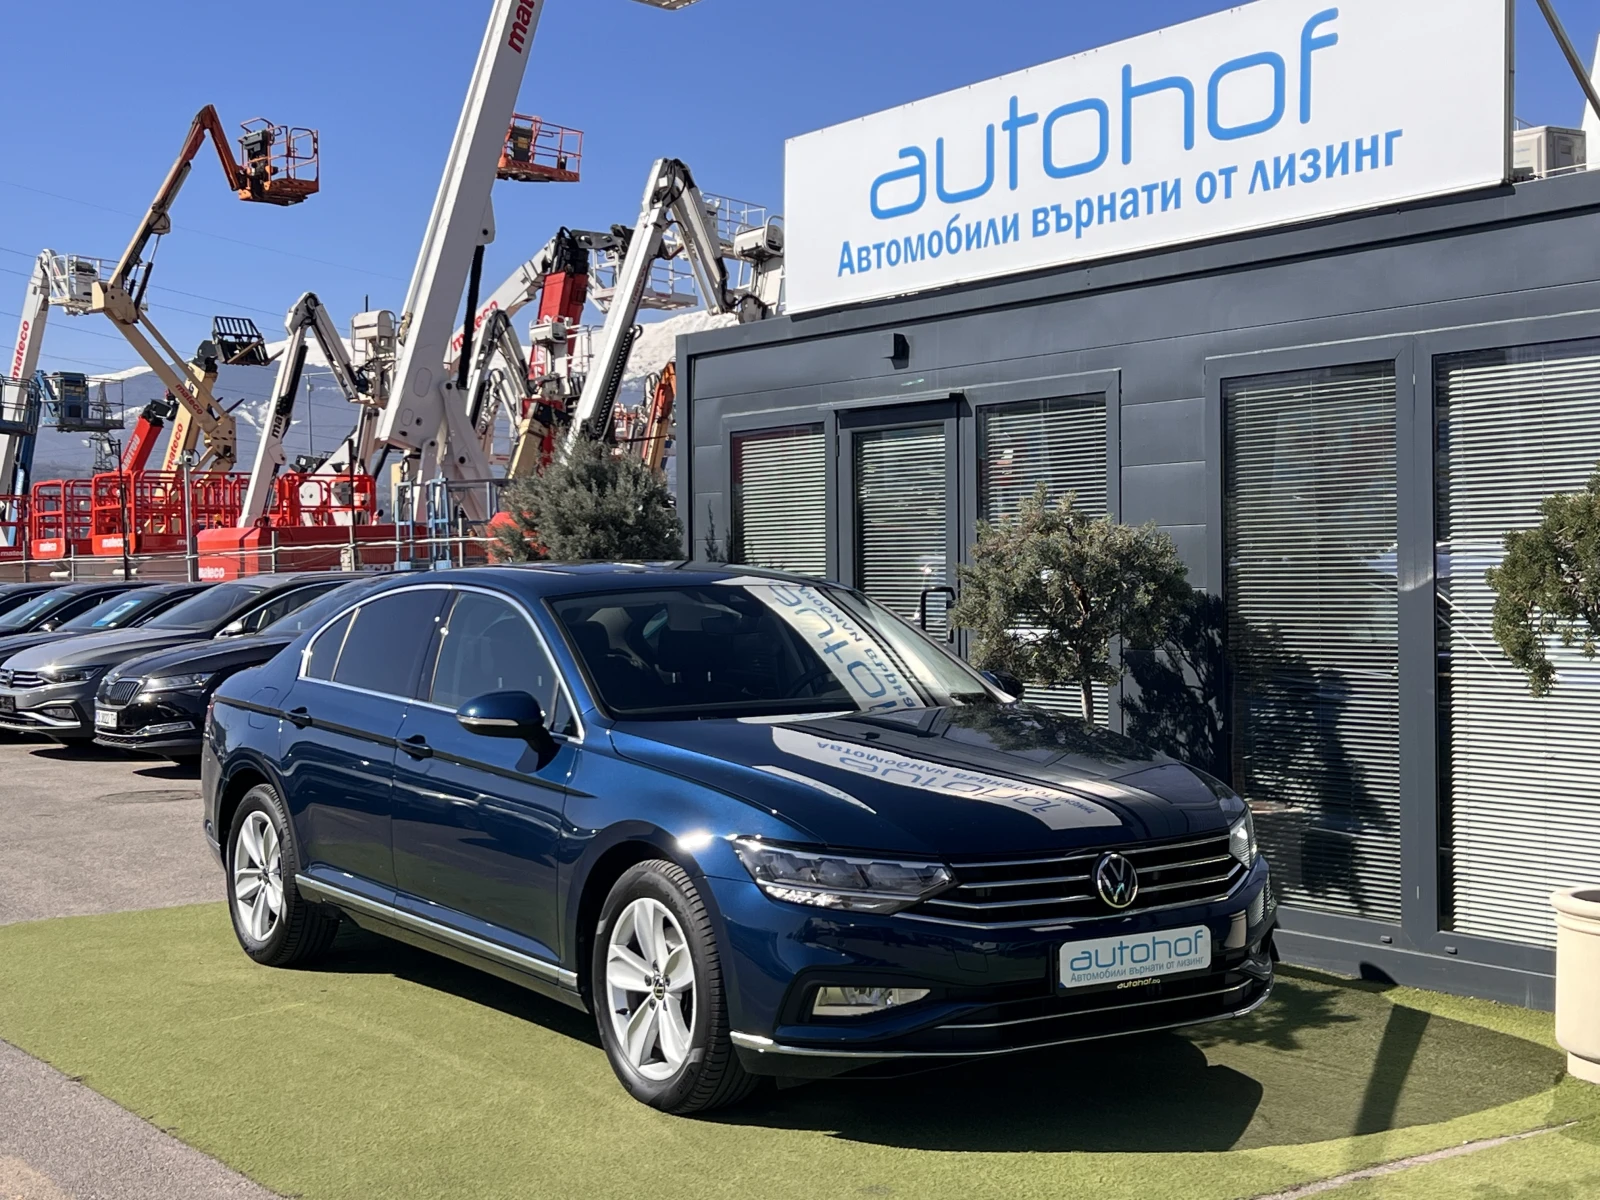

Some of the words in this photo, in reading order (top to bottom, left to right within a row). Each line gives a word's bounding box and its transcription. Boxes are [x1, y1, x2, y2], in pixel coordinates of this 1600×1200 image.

[869, 8, 1339, 221] autohof
[837, 213, 1020, 277] Автомобили
[1031, 170, 1182, 240] върнати
[1195, 164, 1238, 205] от
[1248, 128, 1403, 194] лизинг
[175, 384, 204, 415] mateco
[166, 423, 184, 472] mateco
[1069, 929, 1204, 972] autohof
[1070, 967, 1127, 984] Автомобили
[1129, 962, 1165, 976] върнати
[1166, 961, 1175, 970] от
[1176, 956, 1205, 969] лизинг
